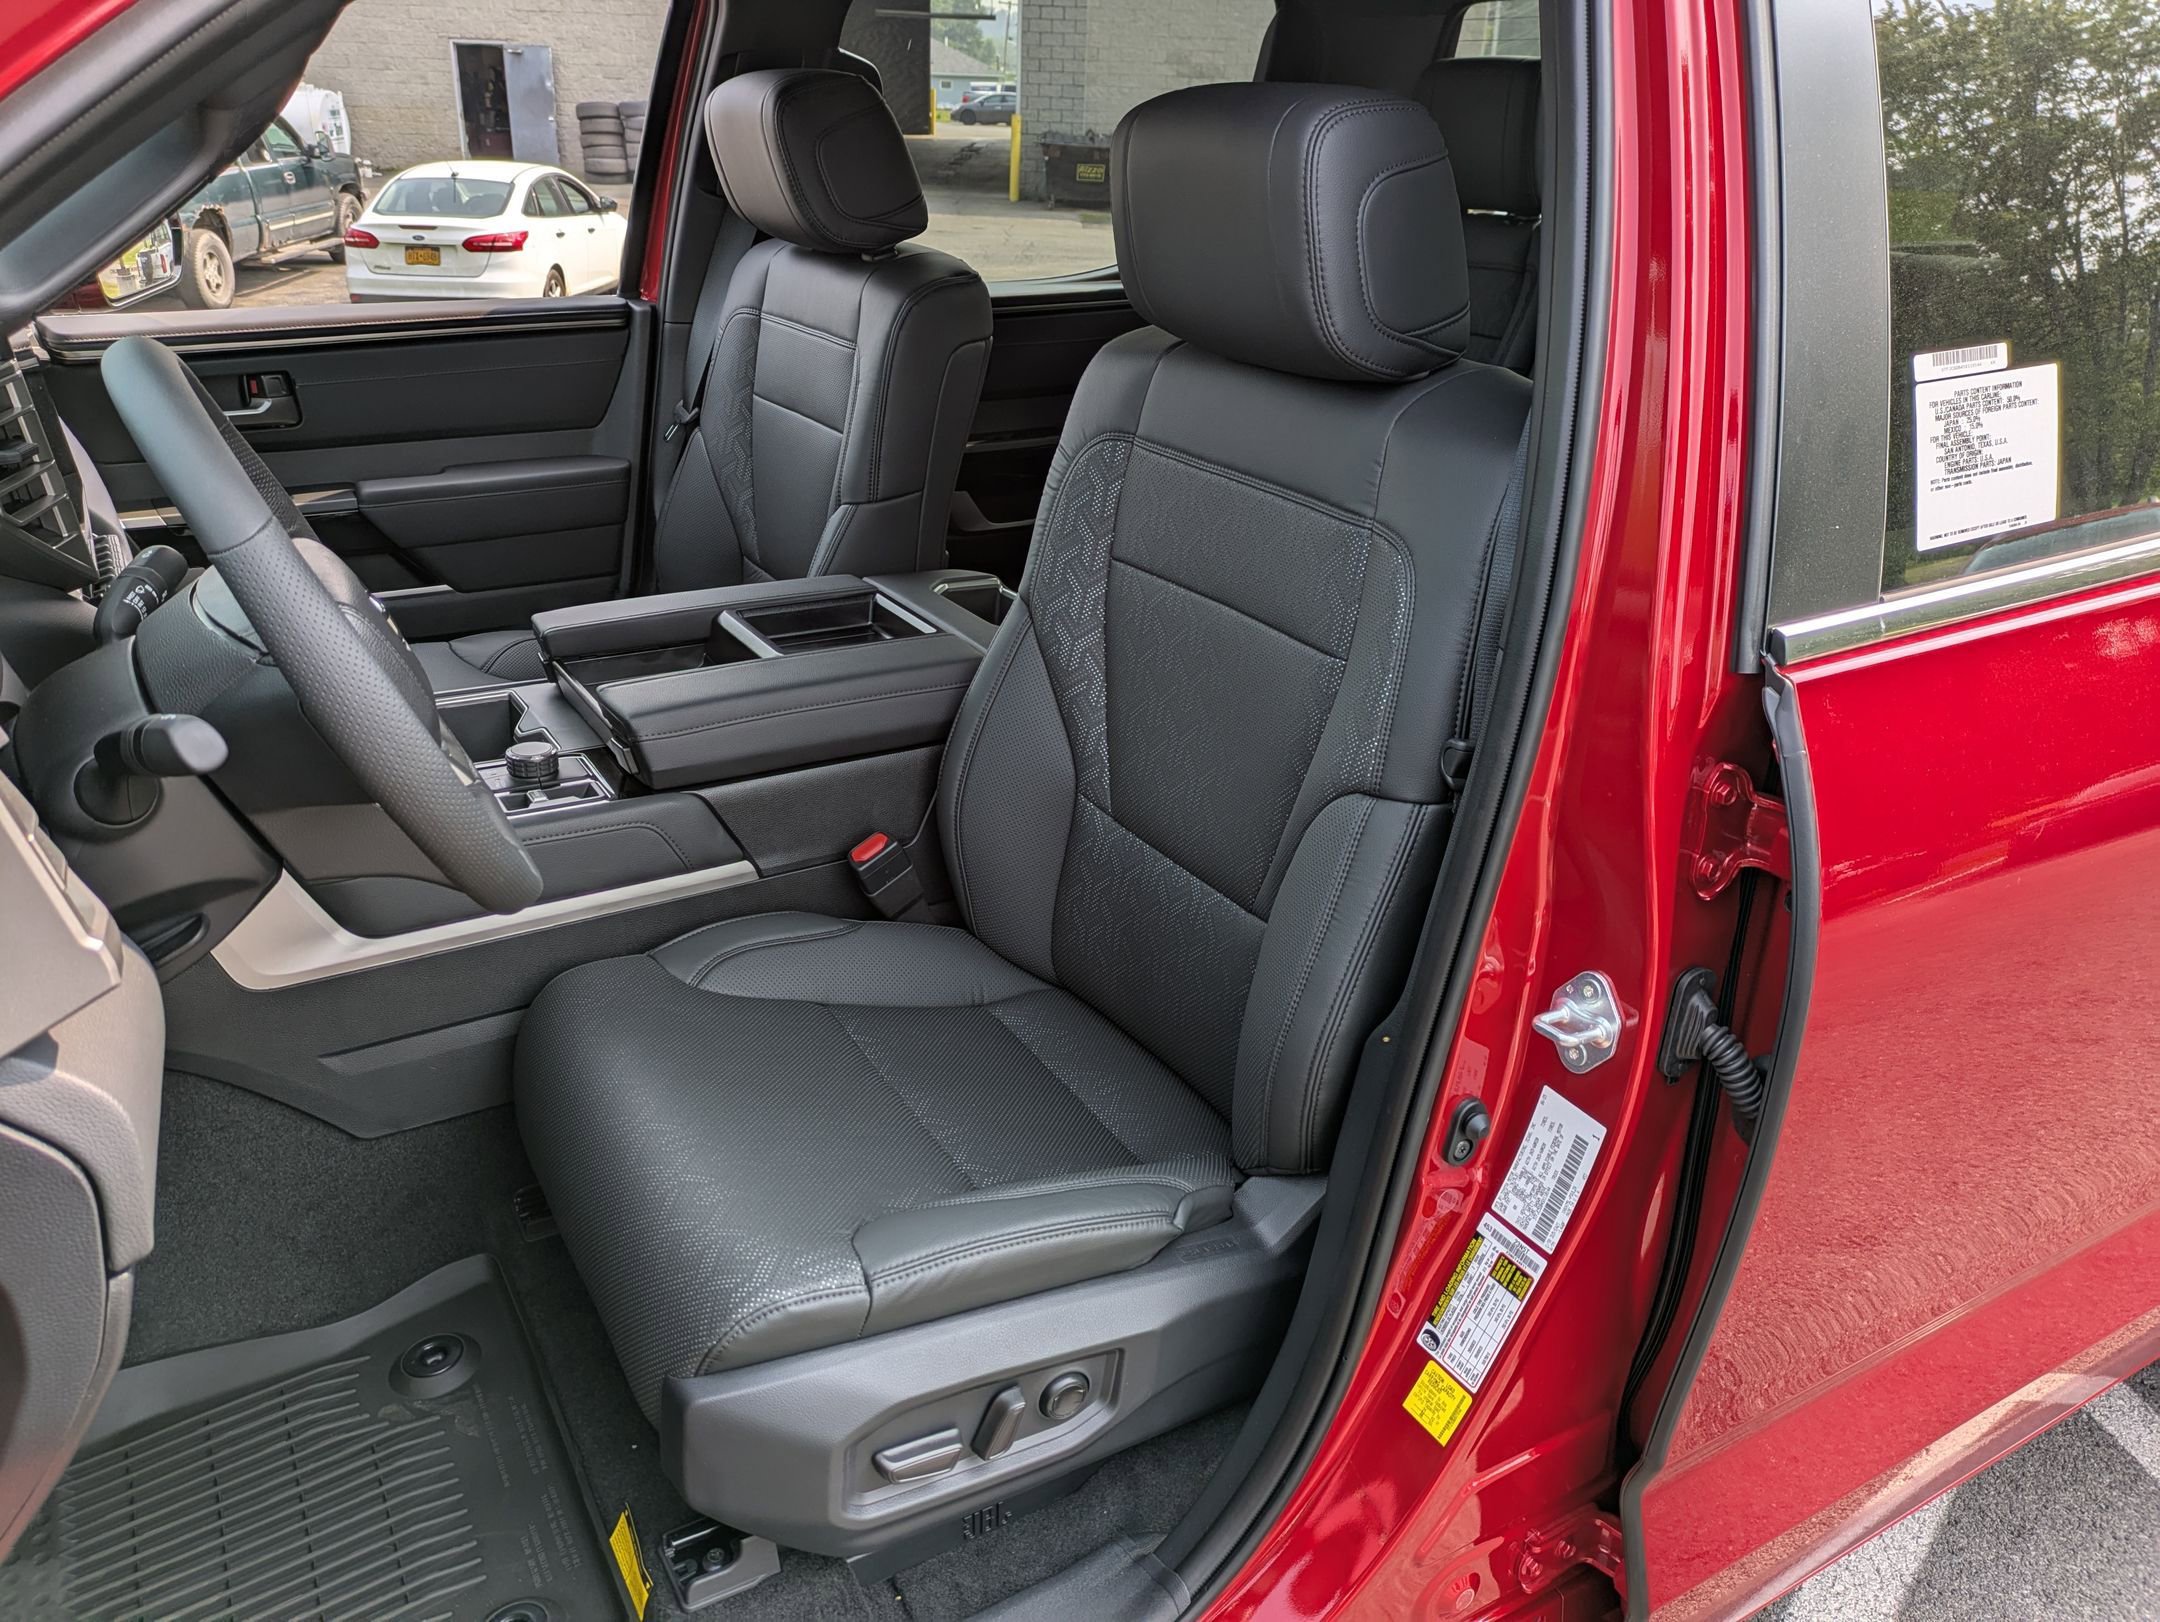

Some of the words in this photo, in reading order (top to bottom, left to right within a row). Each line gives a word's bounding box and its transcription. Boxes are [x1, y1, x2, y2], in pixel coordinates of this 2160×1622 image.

[1954, 389, 1969, 398] PARTS
[1970, 386, 1991, 395] CONTENT
[1992, 381, 2022, 391] INFORMATION
[1940, 397, 1962, 407] VEHICLES
[1952, 409, 1974, 419] SOURCES
[1982, 405, 2002, 414] FOREIGN
[1950, 437, 1975, 447] ASSEMBLY
[1936, 453, 1958, 463] COUNTRY
[1944, 460, 1961, 468] ENGINE
[1944, 463, 1978, 475] TRANSMISSION
[1997, 456, 2012, 466] JAPAN
[1455, 1238, 1476, 1272] INFORMATION
